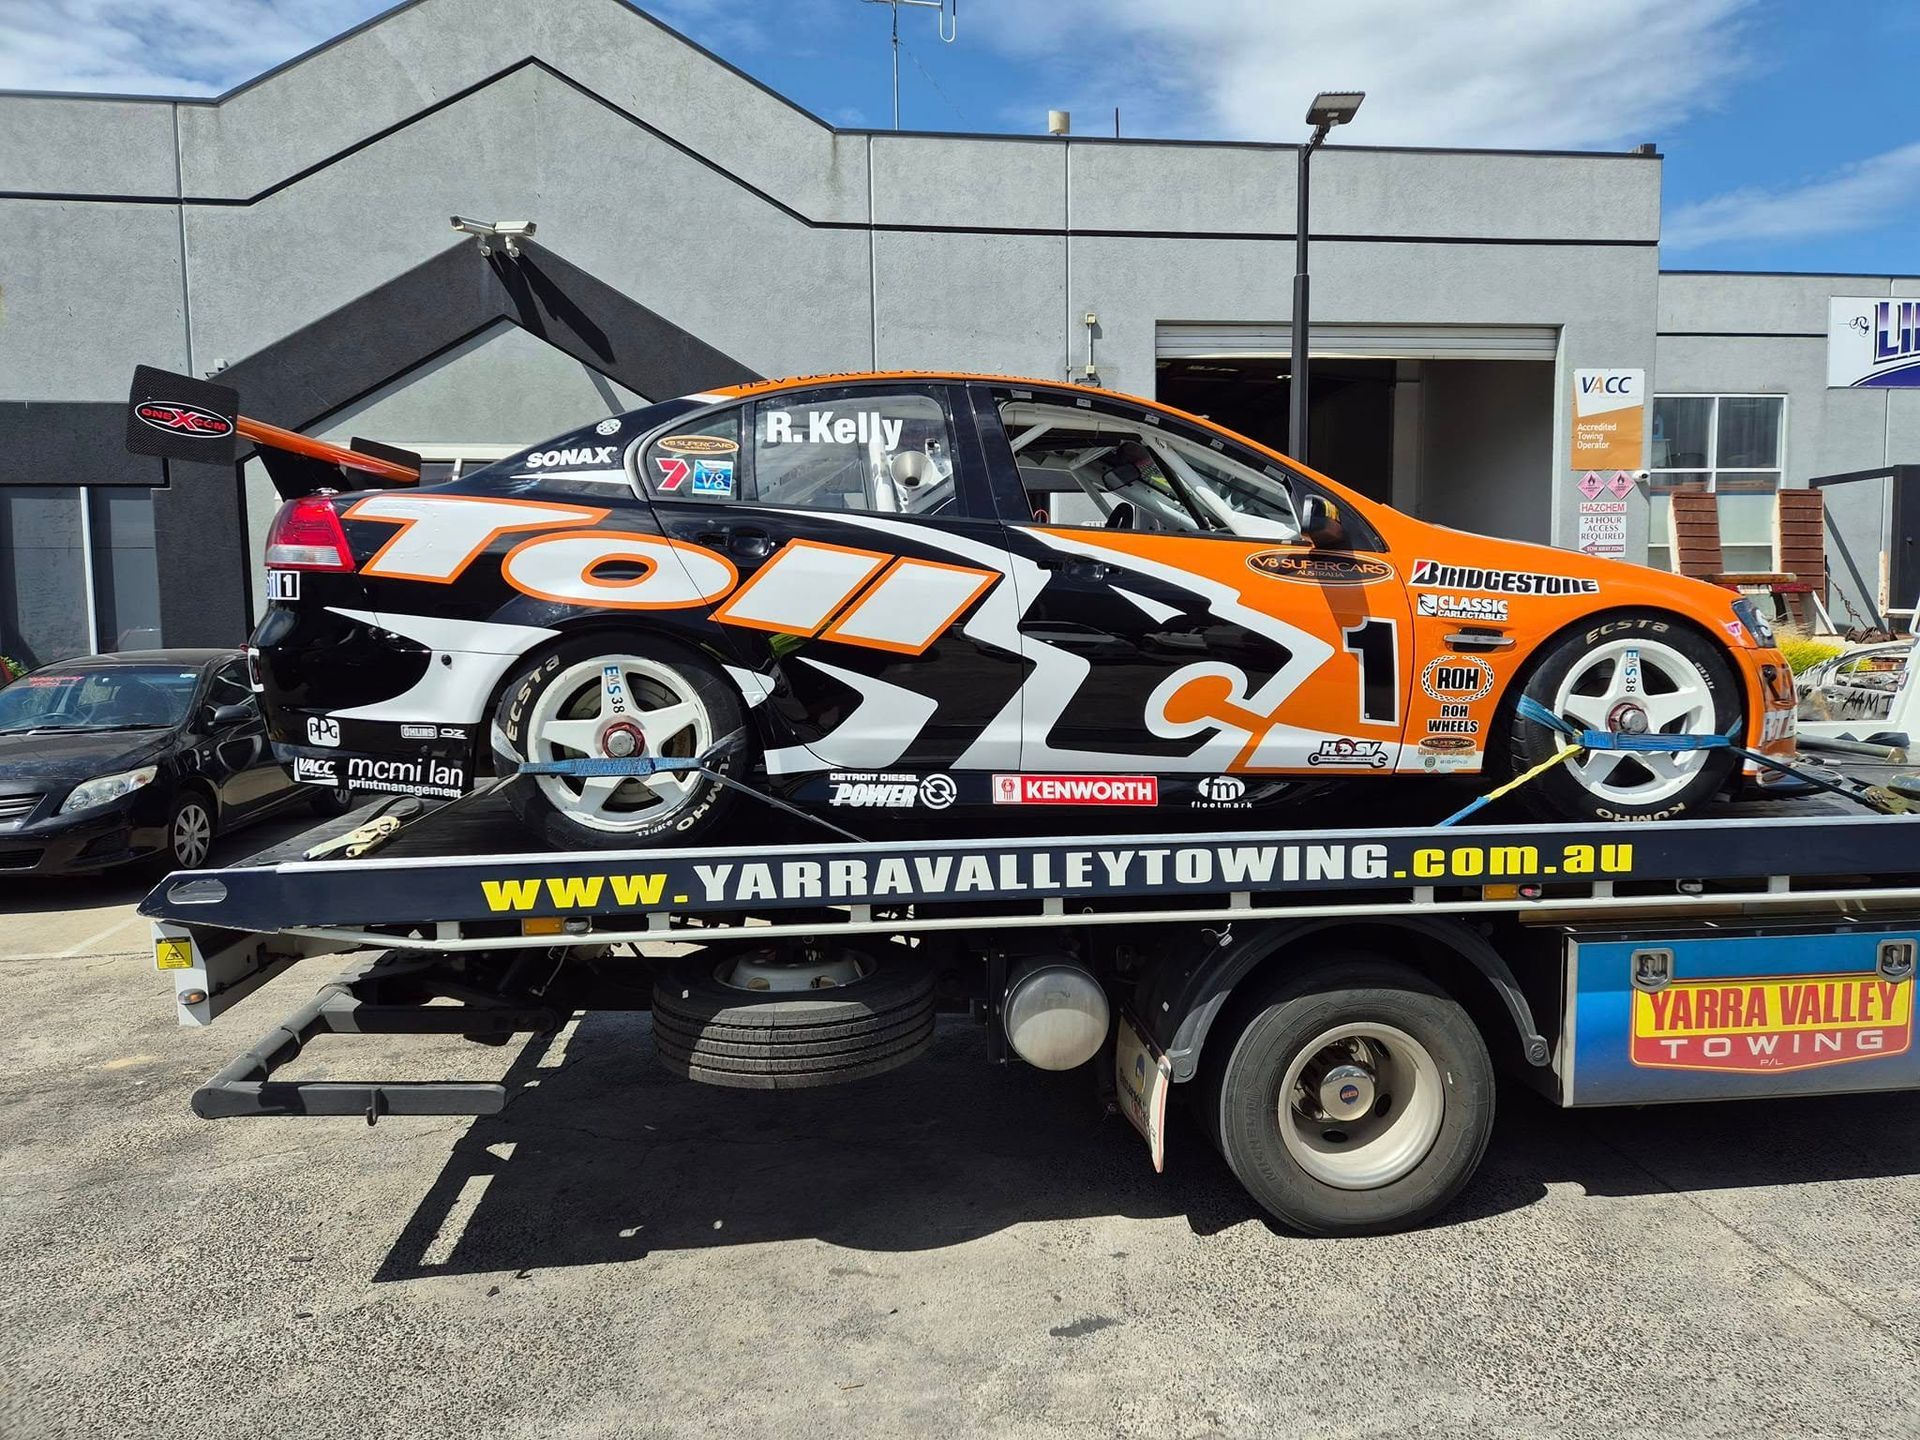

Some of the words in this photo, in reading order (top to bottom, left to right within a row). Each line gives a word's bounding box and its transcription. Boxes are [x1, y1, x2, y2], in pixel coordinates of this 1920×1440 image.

[1581, 376, 1632, 394] VACC
[766, 411, 802, 443] R.
[810, 411, 904, 451] Kelly
[1577, 423, 1617, 431] Accredited
[1577, 432, 1604, 441] Towing
[1577, 441, 1610, 450] Operator
[526, 446, 614, 469] SONAX
[702, 472, 724, 489] V8
[1581, 503, 1625, 512] HAZCHEM
[1584, 516, 1594, 524] 24
[1596, 516, 1622, 524] HOUR
[1581, 533, 1625, 541] REQUIRED
[1255, 556, 1278, 568] V8
[1281, 557, 1387, 575] SUPERCARS
[1297, 569, 1345, 578] AUSTRALIA
[1412, 561, 1598, 594] BRIDGESTONE
[1438, 595, 1509, 613] CLASSIC
[1437, 610, 1509, 621] CARLECTABLES
[1343, 618, 1398, 724] 1
[1437, 667, 1480, 690] ROH
[1625, 677, 1636, 693] 38
[611, 697, 626, 714] 38
[1441, 704, 1469, 717] ROH
[309, 720, 338, 740] PPG
[1427, 719, 1479, 733] WHEELS
[299, 757, 336, 774] VACC
[829, 773, 879, 781] DETROIT
[880, 774, 919, 782] DIESEL
[348, 778, 463, 799] printmanagement
[830, 783, 918, 807] POWER
[1026, 780, 1153, 801] KENWORTH
[480, 843, 1634, 912] www.YARRAVALLEYTOWING.com.au
[1650, 986, 1768, 1031] YARRA
[1779, 981, 1899, 1026] VALLEY
[1660, 1029, 1884, 1060] TOWING
[1760, 1058, 1784, 1066] P/L
